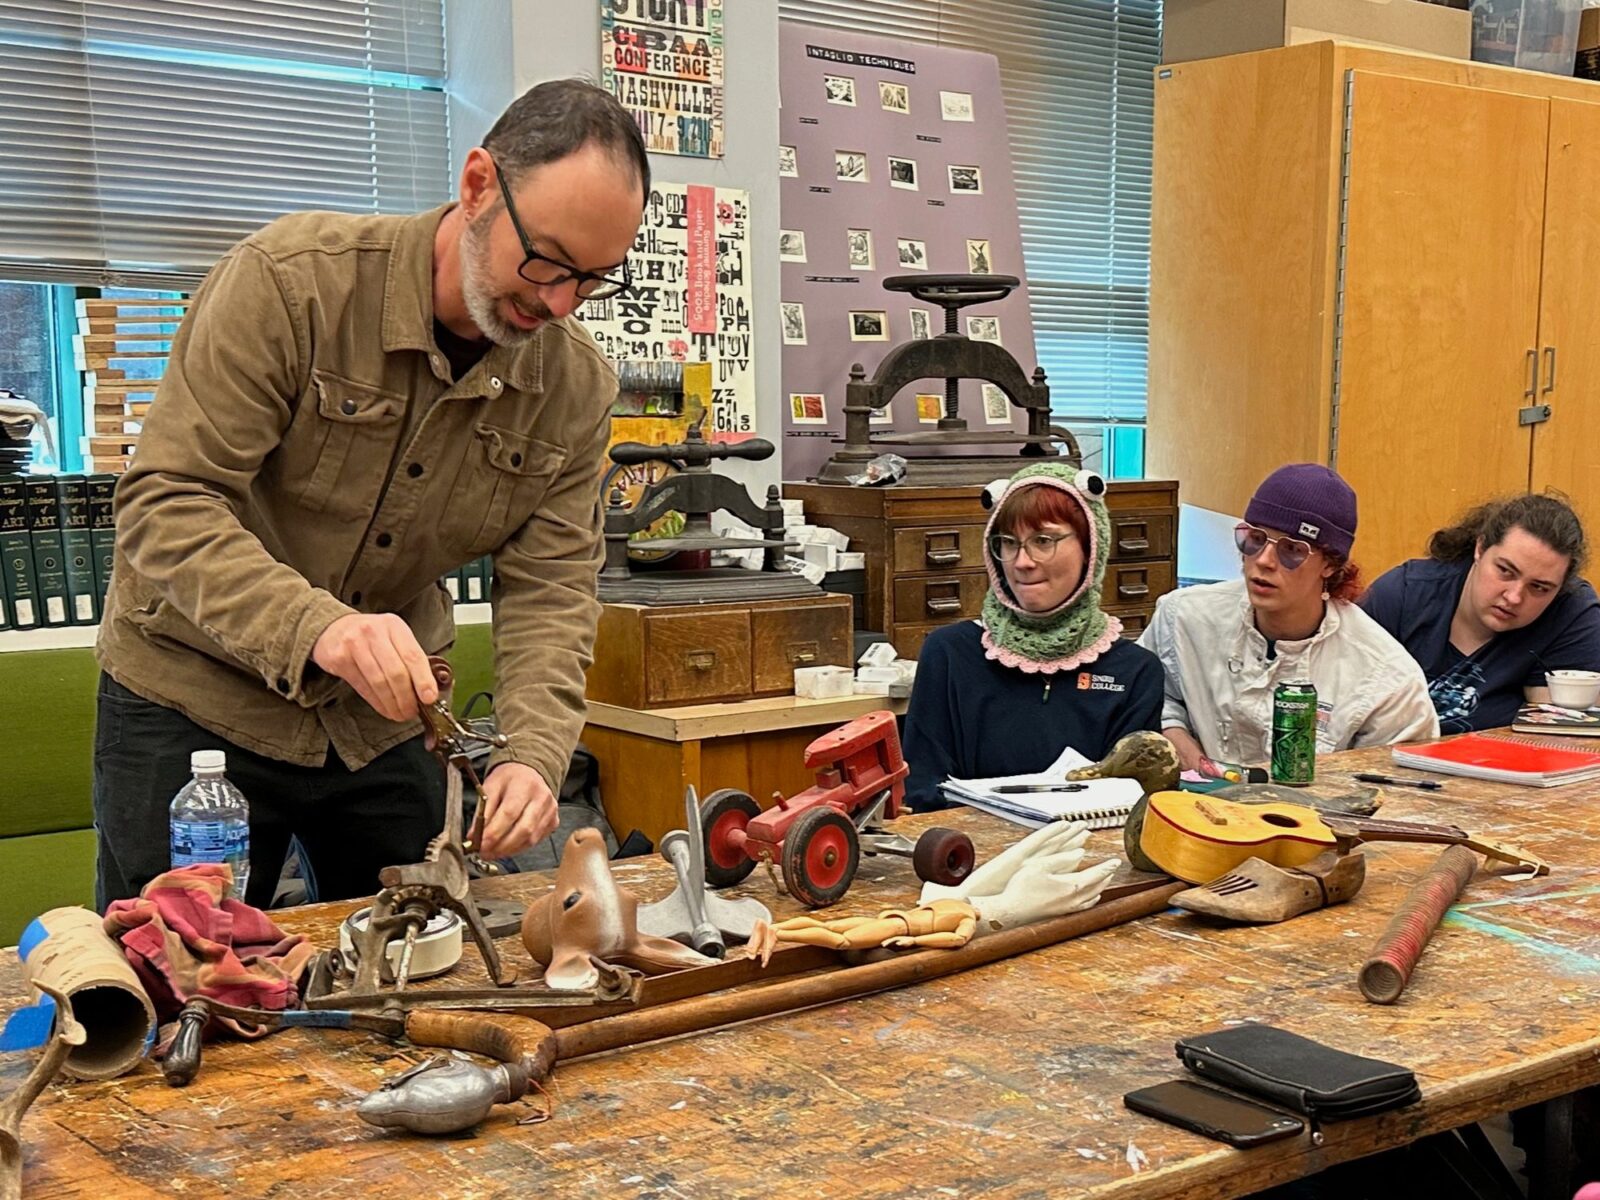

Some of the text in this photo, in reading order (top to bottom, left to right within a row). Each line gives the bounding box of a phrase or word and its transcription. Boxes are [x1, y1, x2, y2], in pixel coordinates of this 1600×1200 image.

[614, 47, 711, 77] CONFERENCE
[712, 27, 723, 80] MIGHT
[808, 47, 915, 72] INTAGLIO TECHNIQUES
[615, 76, 712, 115] NASHVILLE
[713, 87, 723, 131] HUNT
[693, 207, 705, 288] Book and Paper
[703, 230, 711, 311] Summer Schedule
[2, 516, 25, 528] ART
[33, 515, 57, 527] ART
[64, 515, 88, 526] ART
[1092, 682, 1125, 692] COLLEGE
